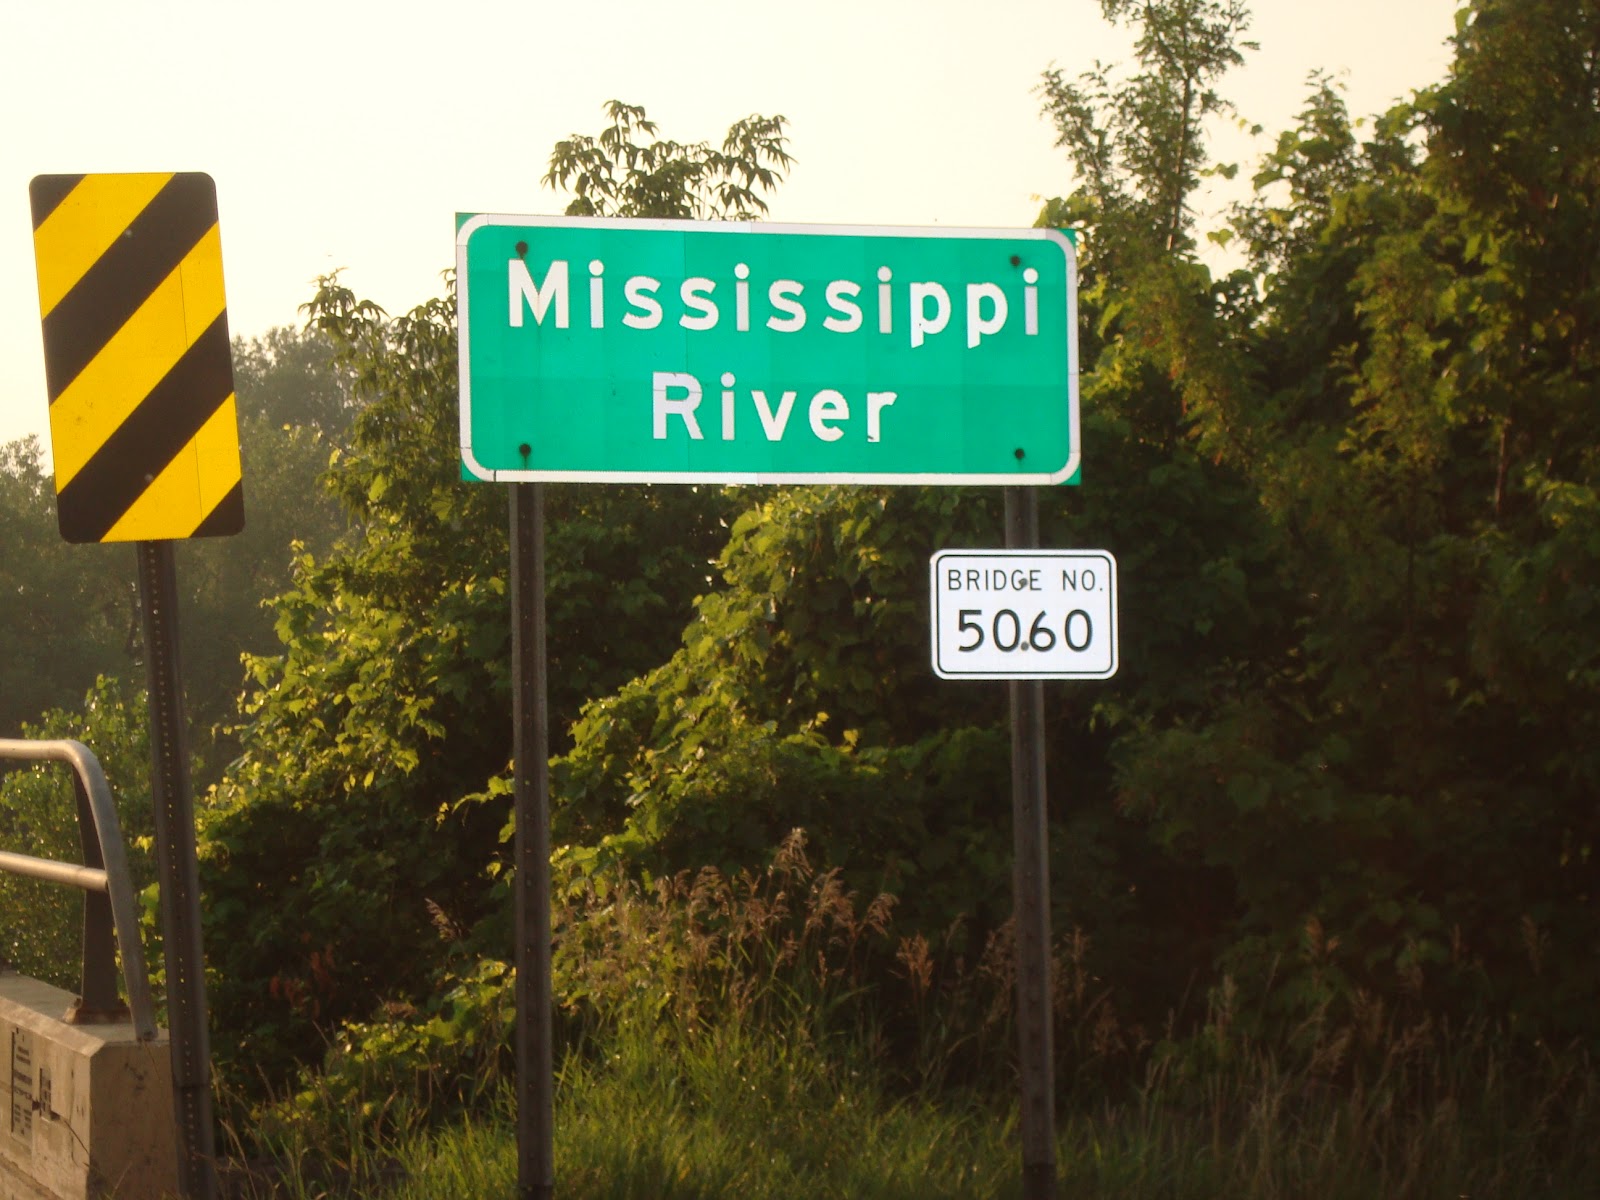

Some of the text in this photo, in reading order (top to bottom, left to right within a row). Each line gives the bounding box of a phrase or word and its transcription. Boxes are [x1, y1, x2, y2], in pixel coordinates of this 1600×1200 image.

[508, 259, 1039, 348] Mississippi
[652, 372, 897, 442] River
[948, 569, 1104, 591] BRIDGE NO.
[958, 608, 1093, 653] 5060
